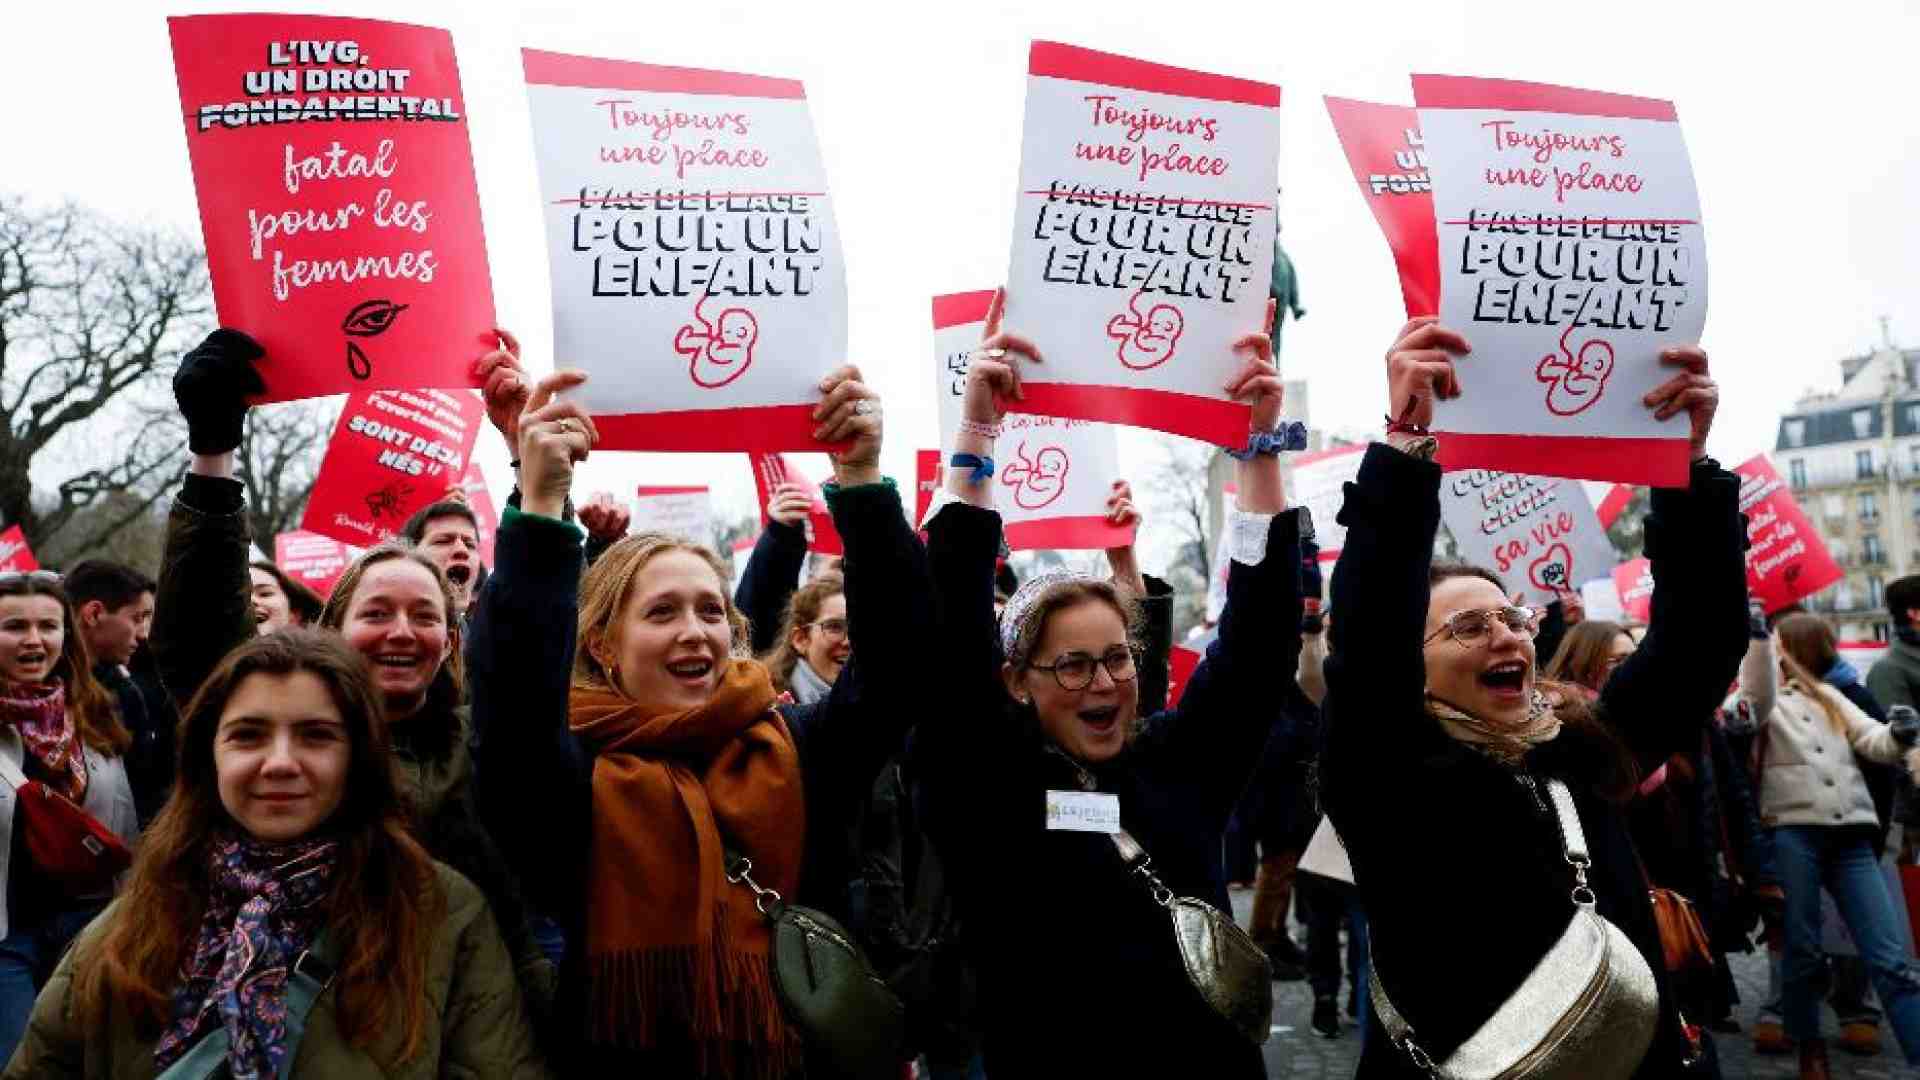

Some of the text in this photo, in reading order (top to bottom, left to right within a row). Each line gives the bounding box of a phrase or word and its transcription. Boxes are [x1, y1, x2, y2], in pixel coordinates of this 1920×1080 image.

[268, 40, 369, 67] L'IVG,
[245, 68, 410, 96] UN DROIT
[198, 97, 461, 132] FONDAMENTAL
[595, 98, 751, 141] Toujours
[1084, 95, 1221, 143] Toujours
[600, 139, 768, 179] une place
[1073, 141, 1229, 181] une place
[1481, 120, 1627, 164] Toujours
[284, 139, 398, 193] fatal
[1486, 162, 1643, 202] une place
[249, 189, 432, 260] pour les
[573, 213, 822, 254] POUR UN
[1034, 203, 1258, 266] POUR UN
[273, 249, 438, 301] femmes
[592, 255, 823, 297] ENFANT
[1043, 246, 1257, 302] ENFANT
[1461, 235, 1690, 287] POUR UN
[1473, 279, 1688, 331] ENFANT
[1495, 511, 1574, 573] sa vie
